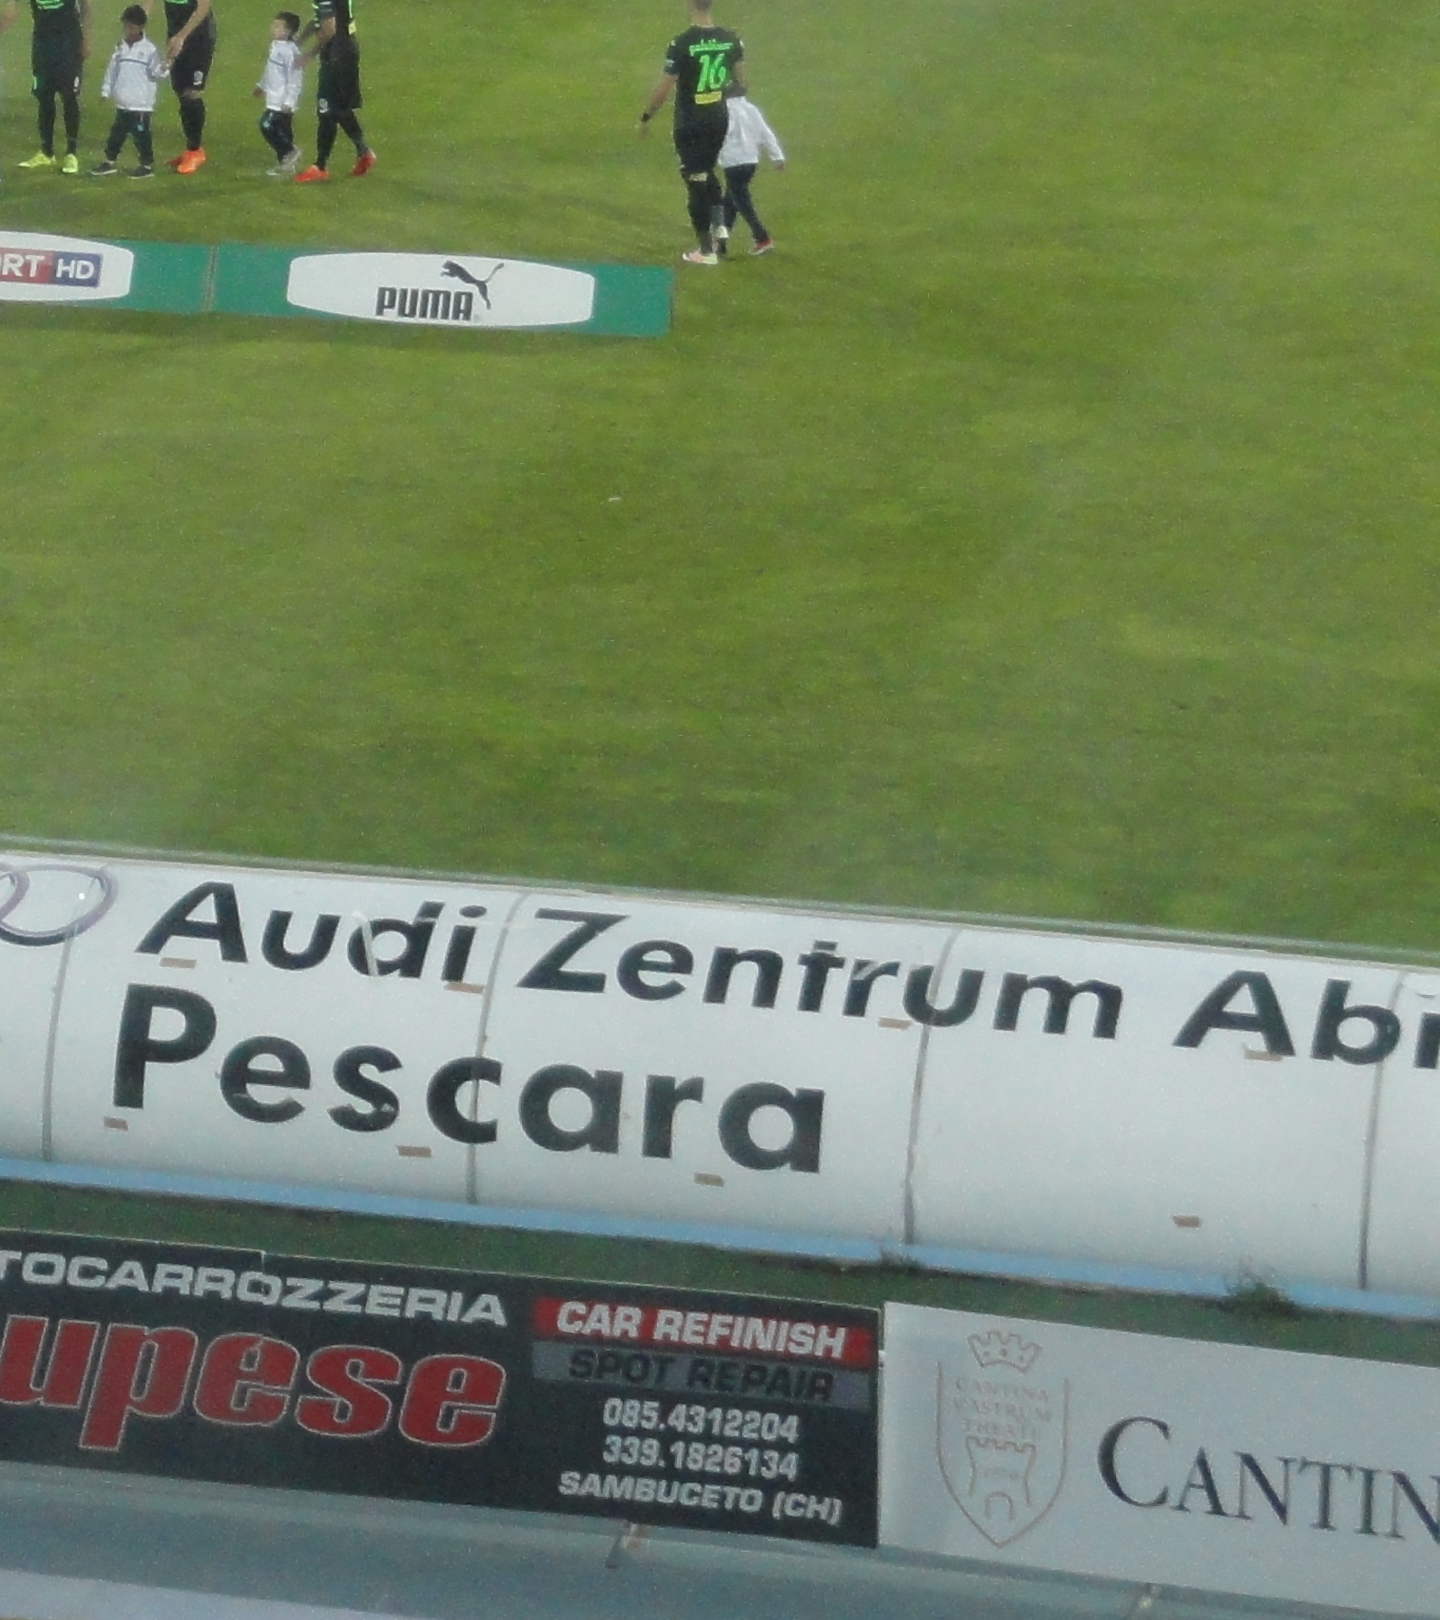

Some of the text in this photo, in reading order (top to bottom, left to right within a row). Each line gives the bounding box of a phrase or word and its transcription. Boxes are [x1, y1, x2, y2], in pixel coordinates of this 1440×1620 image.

[55, 256, 96, 282] HD
[375, 285, 474, 322] PUMA
[135, 879, 490, 985] Audi
[516, 907, 1125, 1040] Zentrum
[112, 982, 826, 1174] Pescara
[557, 1301, 846, 1359] CAR REFINISH
[568, 1349, 836, 1402] SPOT REPAIR
[602, 1397, 801, 1445] 085.4312204
[602, 1435, 800, 1482] 339.1826134
[558, 1470, 844, 1528] SAMBUCETO (CH)
